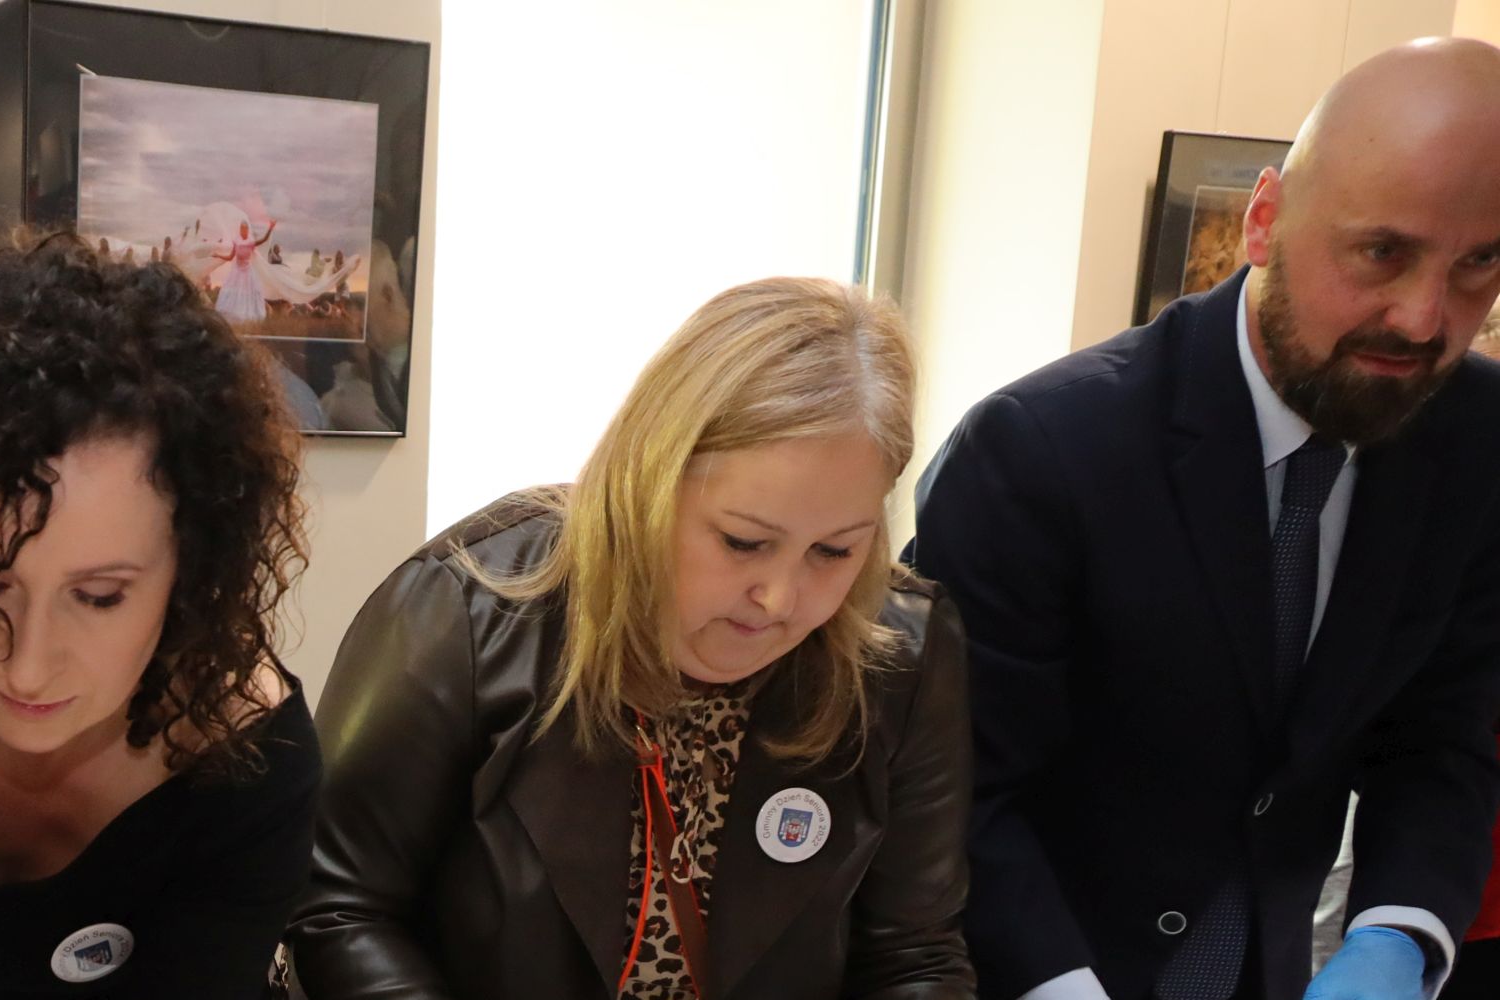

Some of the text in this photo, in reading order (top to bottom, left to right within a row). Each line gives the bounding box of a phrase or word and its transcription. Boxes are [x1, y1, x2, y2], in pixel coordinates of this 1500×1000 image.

[763, 793, 826, 847] Gminny Dzień Seniora 2022
